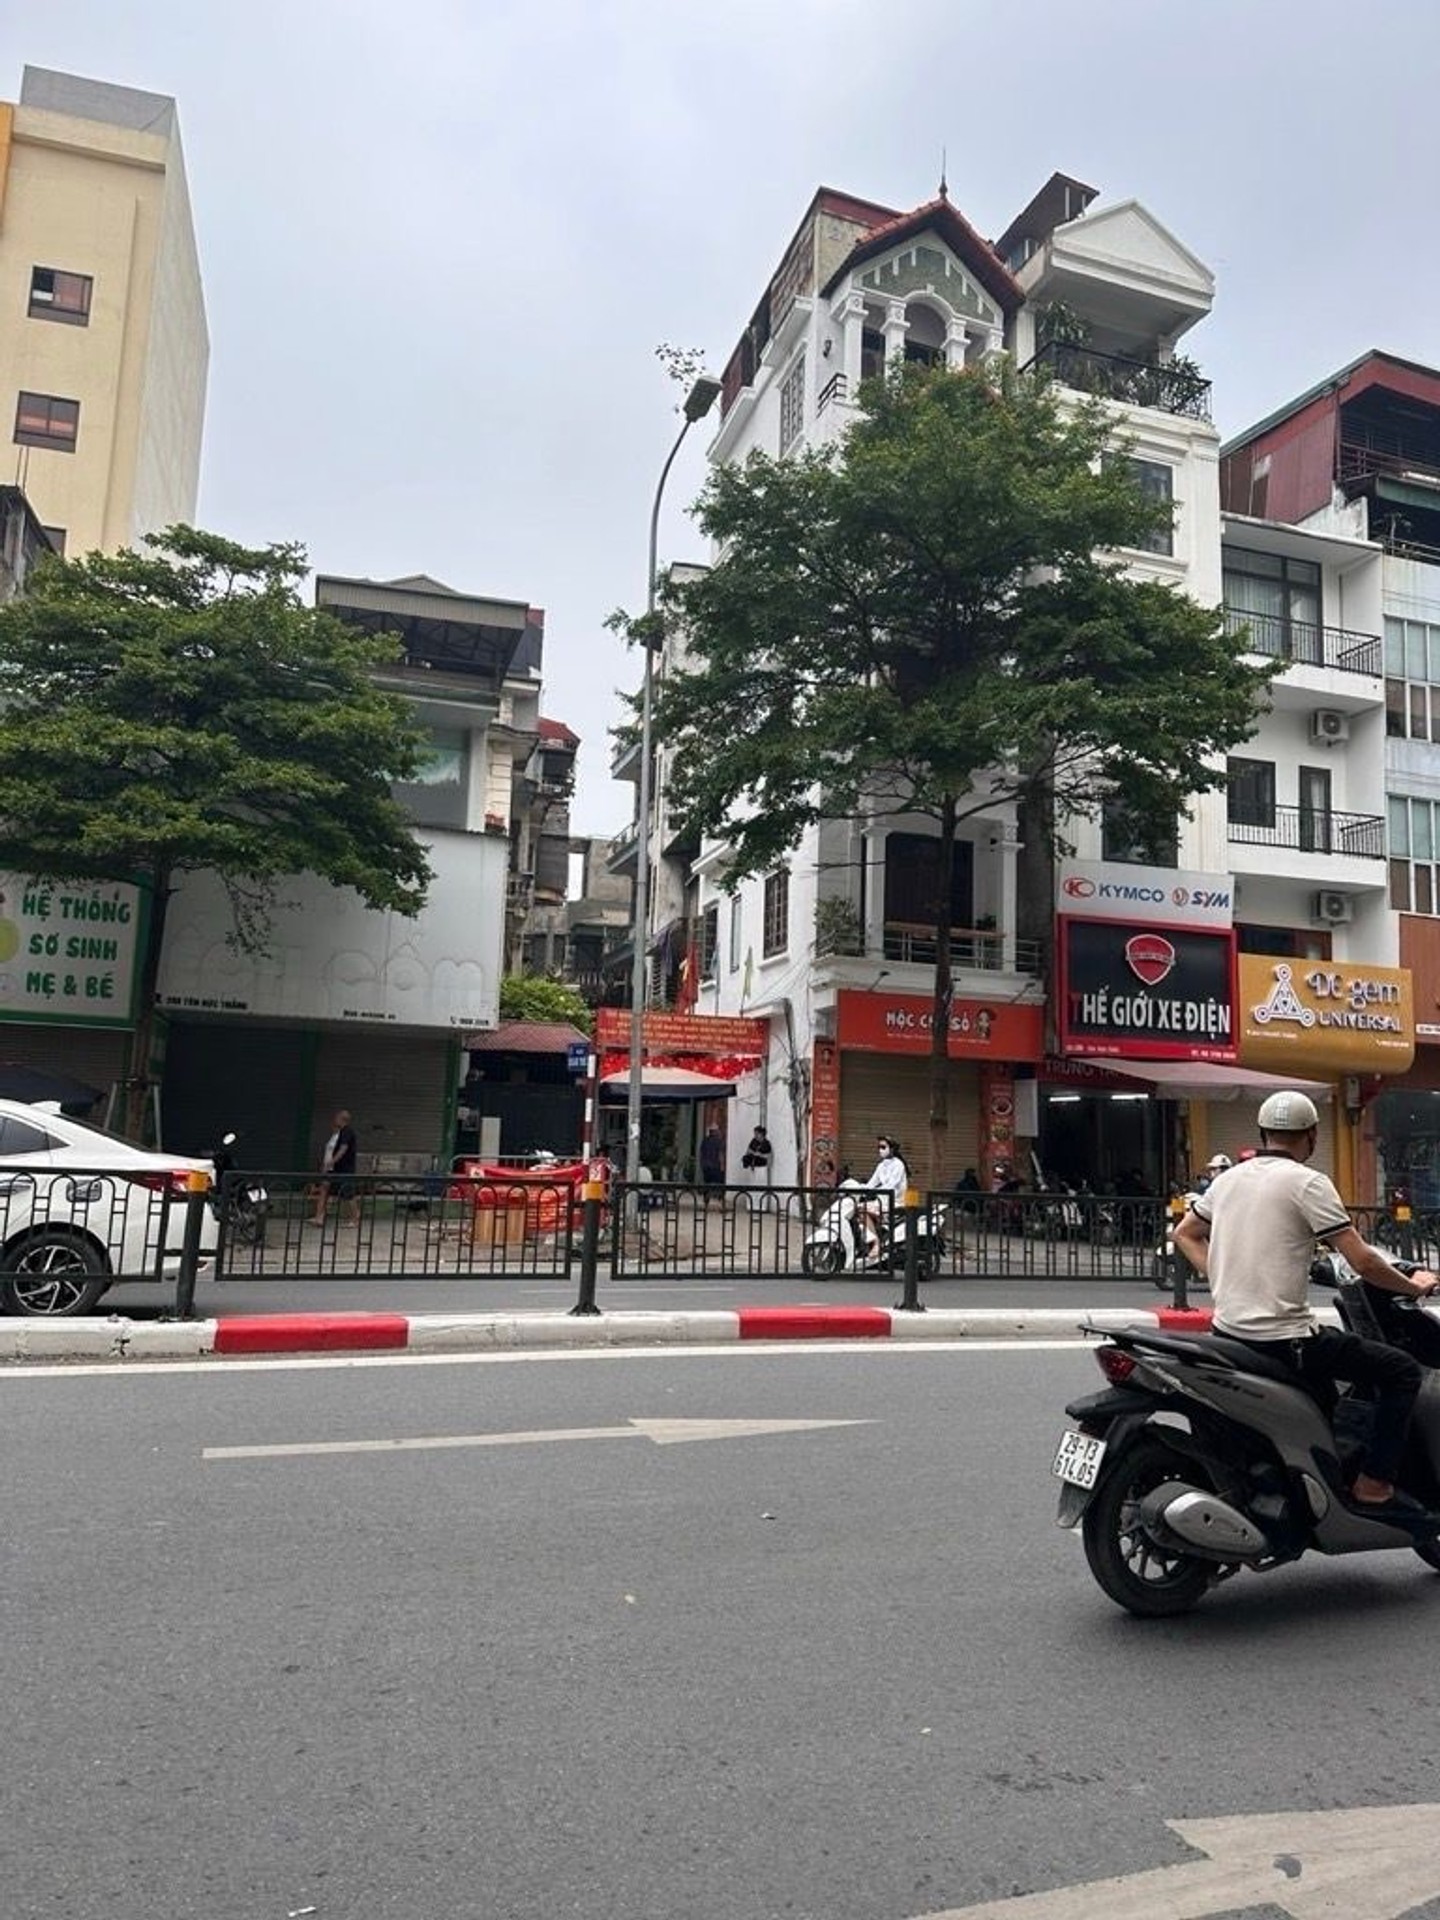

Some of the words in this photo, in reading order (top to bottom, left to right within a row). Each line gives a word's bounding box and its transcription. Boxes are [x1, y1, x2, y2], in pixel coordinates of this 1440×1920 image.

[22, 889, 52, 921] HỆ
[60, 890, 131, 924] THỐNG
[1098, 883, 1165, 904] KYMCO
[1191, 890, 1230, 909] SYM
[65, 936, 118, 960] SINH
[26, 971, 56, 1000] MẸ
[63, 974, 77, 996] &
[85, 972, 114, 998] BÉ
[1347, 978, 1401, 1009] gem
[886, 1008, 915, 1029] MỘC
[1069, 985, 1109, 1025] THẾ
[1112, 990, 1153, 1028] GIỚI
[1157, 998, 1182, 1029] XE
[1184, 998, 1230, 1039] ĐIỆN
[1318, 1010, 1404, 1033] UNIVERSAL
